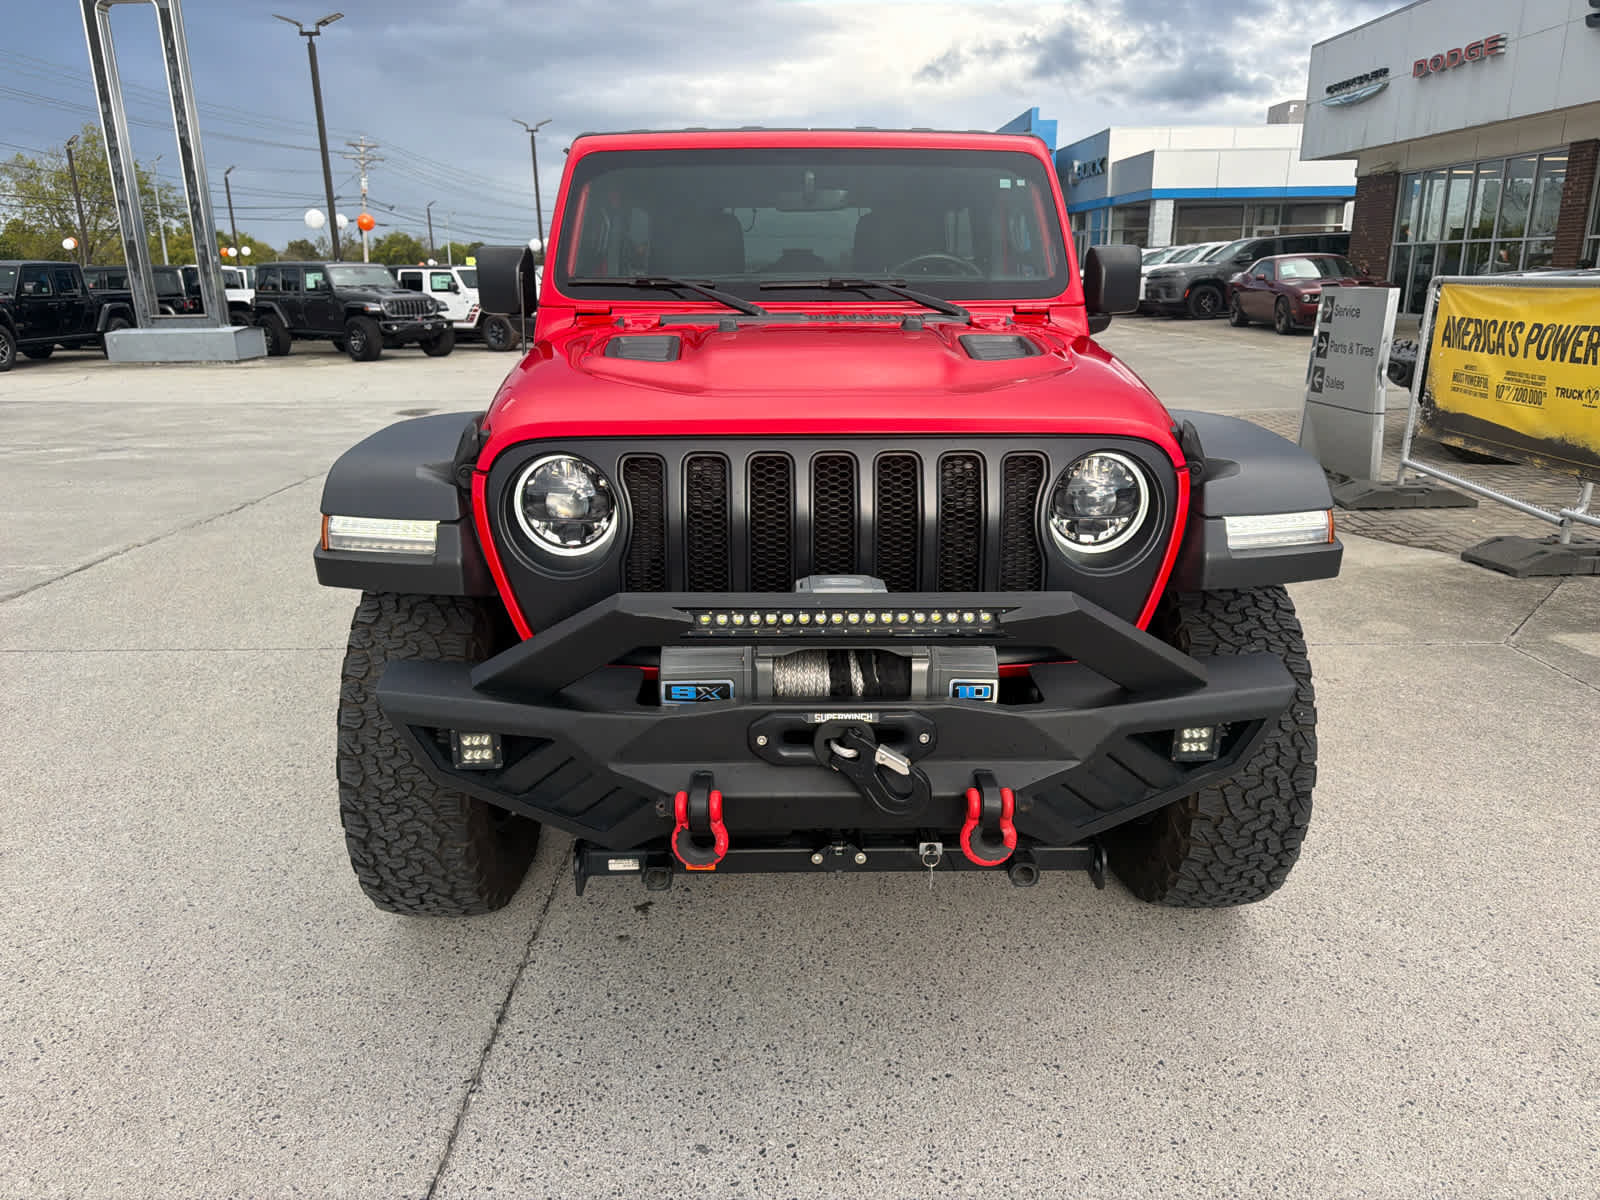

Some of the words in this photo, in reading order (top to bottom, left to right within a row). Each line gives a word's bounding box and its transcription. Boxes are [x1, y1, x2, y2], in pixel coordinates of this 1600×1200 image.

[1412, 32, 1508, 79] DODGE
[1334, 304, 1361, 319] Service
[1441, 315, 1525, 358] AMERICA'S
[1329, 340, 1347, 355] Parts
[1347, 342, 1354, 356] &
[1355, 343, 1375, 358] Tires
[1325, 375, 1345, 391] Sales
[1555, 386, 1585, 401] TRUCK
[955, 685, 991, 699] 10
[814, 713, 873, 723] SUPERWINCH
